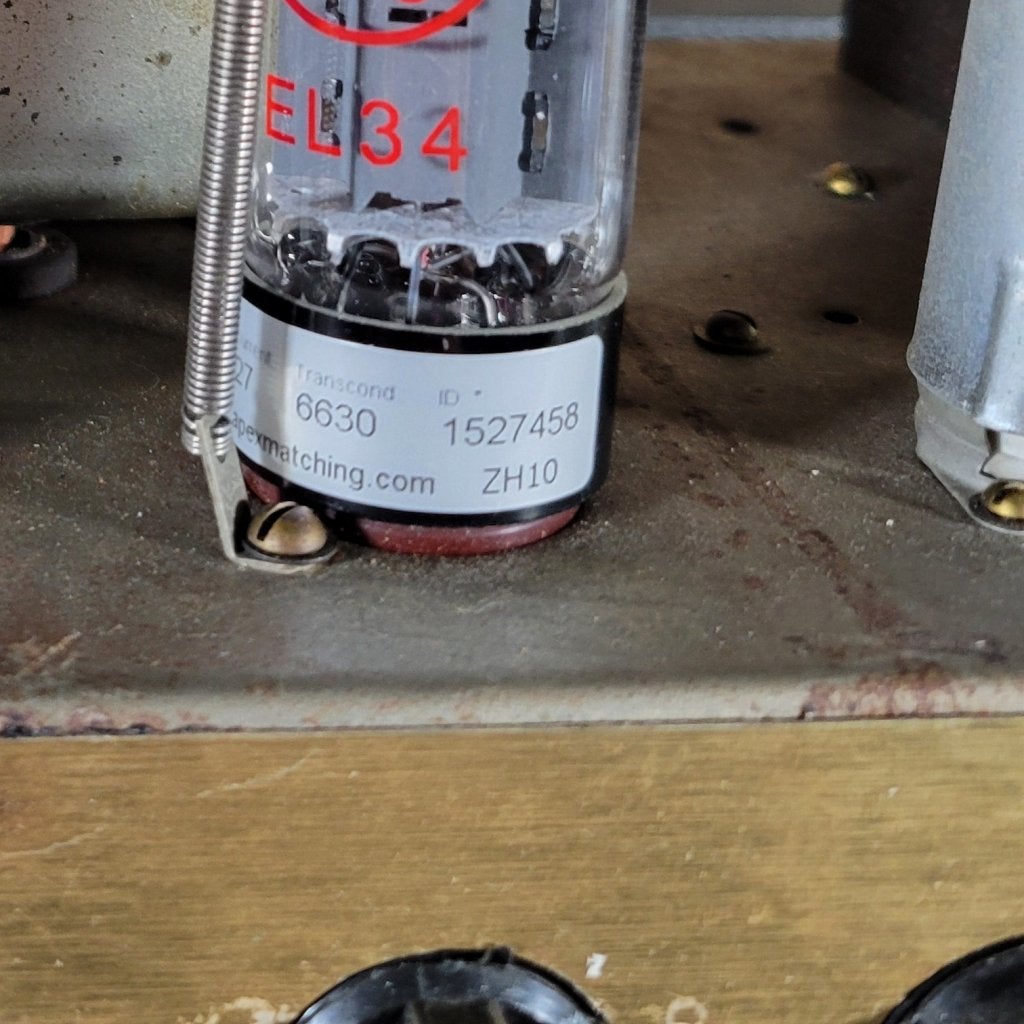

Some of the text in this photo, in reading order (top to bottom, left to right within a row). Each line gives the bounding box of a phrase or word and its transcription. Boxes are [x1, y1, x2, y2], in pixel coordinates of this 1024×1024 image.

[265, 72, 468, 173] EL34
[296, 362, 396, 402] Transcond
[295, 392, 580, 447] 6630 1527458
[481, 458, 559, 496] ZH10
